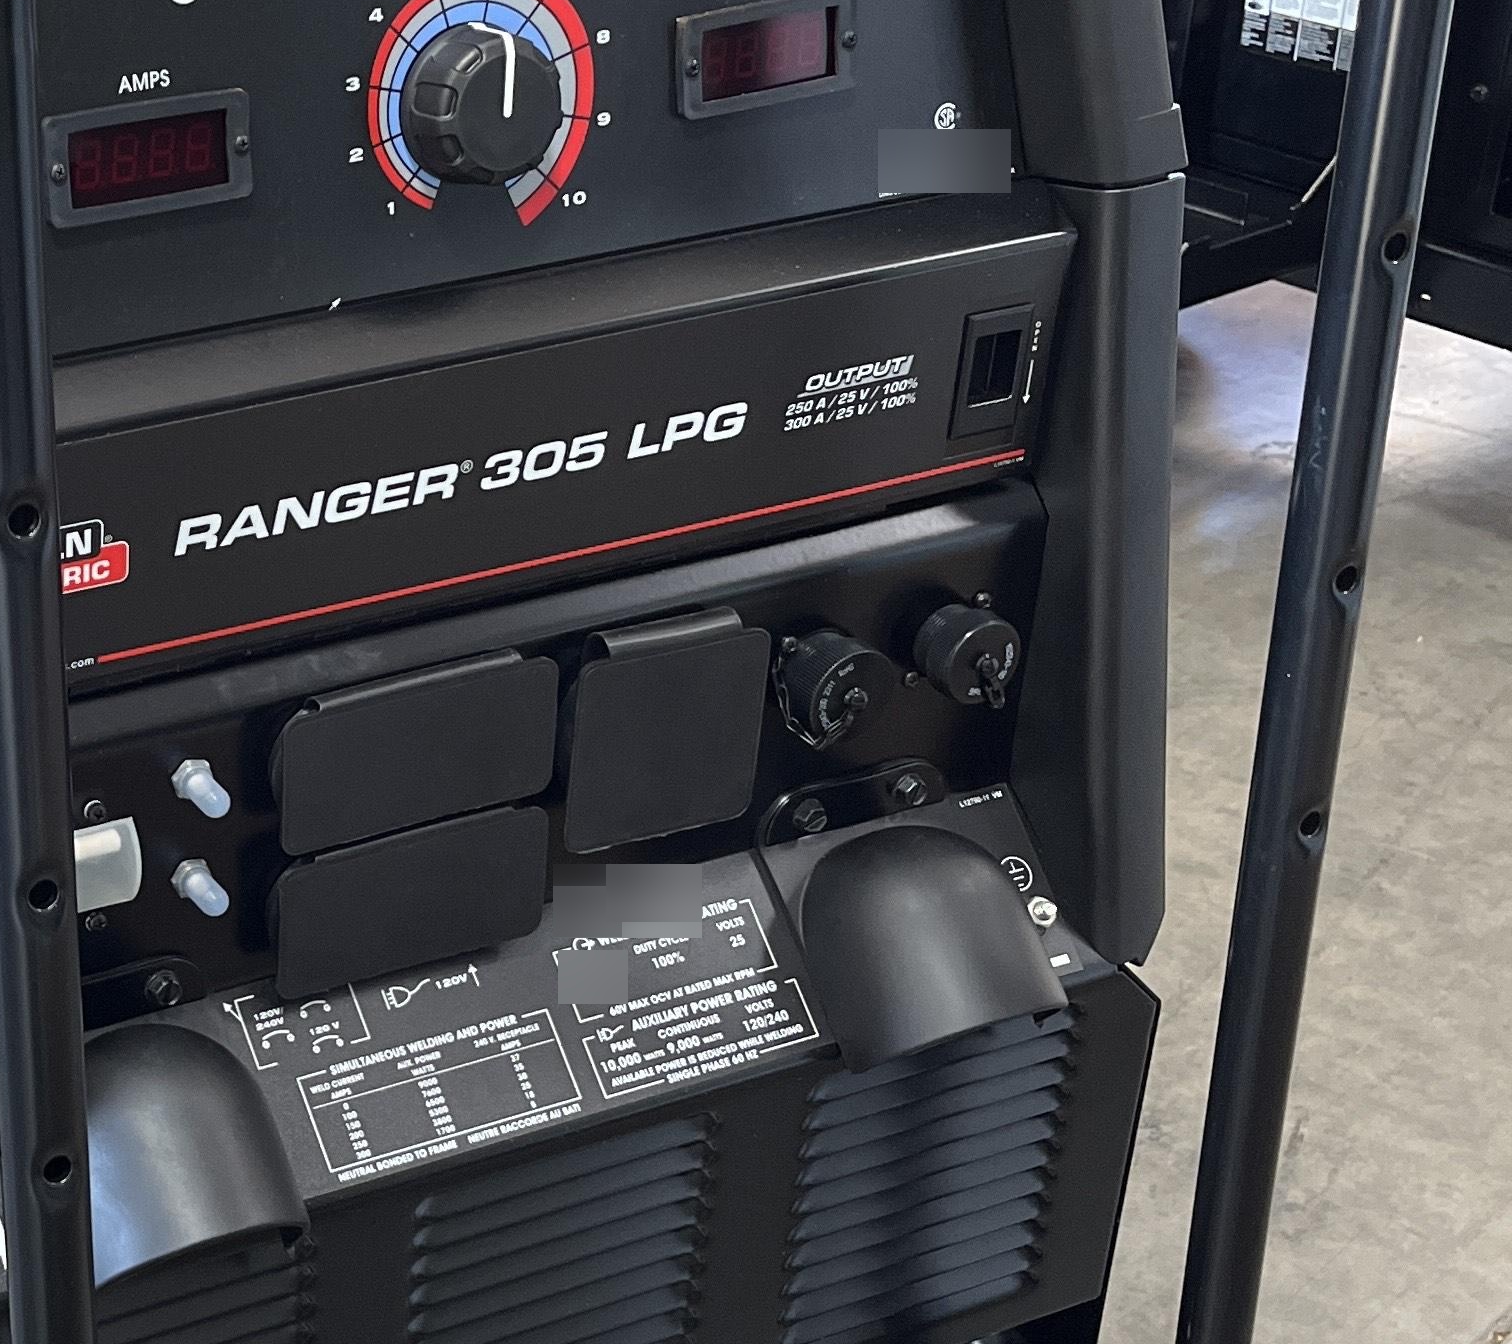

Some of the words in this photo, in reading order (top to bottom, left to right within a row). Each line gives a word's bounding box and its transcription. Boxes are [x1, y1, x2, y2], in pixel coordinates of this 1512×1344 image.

[368, 7, 384, 23] 4
[596, 29, 611, 44] 8
[118, 68, 171, 94] AMPS
[345, 76, 361, 92] 3
[596, 111, 611, 127] 9
[348, 148, 364, 163] 2
[561, 190, 587, 207] 10
[387, 202, 396, 216] 1
[805, 356, 908, 392] OUTPUT
[785, 399, 814, 416] 250
[783, 415, 811, 431] 300
[480, 431, 608, 491] 305
[626, 402, 748, 461] LPG
[701, 898, 738, 919] ATING
[715, 916, 745, 931] VOLTS
[632, 940, 657, 955] DUTY
[729, 933, 746, 948] 25
[651, 951, 686, 969] 100%
[435, 972, 467, 989] 120V
[609, 1003, 627, 1016] 60V
[628, 997, 650, 1011] MAX
[650, 991, 672, 1004] OCV
[673, 987, 684, 999] AT
[684, 979, 713, 995] RATED
[712, 974, 735, 987] MAX
[733, 967, 755, 981] RPM
[632, 1004, 689, 1031] AUXILIARY
[689, 992, 734, 1014] POWER
[734, 980, 778, 1002] RATING
[744, 998, 775, 1014] VOLTS
[255, 1016, 284, 1031] 240V
[309, 1024, 331, 1036] 120
[331, 1021, 340, 1029] V
[657, 1013, 721, 1039] CONTINUOUS
[742, 1009, 790, 1032] 120/240
[329, 1045, 407, 1076] SIMULTANEOUS
[406, 1031, 455, 1054] WELDING
[456, 1025, 479, 1040] AND
[479, 1014, 518, 1033] POWER
[610, 1037, 637, 1053] PEAK
[666, 1035, 701, 1054] 9,000
[414, 1051, 442, 1065] POWER
[600, 1052, 642, 1073] 10,000
[611, 1066, 655, 1087] AVAILABLE
[654, 1057, 687, 1074] POWER
[687, 1054, 697, 1065] IS
[696, 1043, 738, 1062] REDUCED
[737, 1034, 765, 1050] WHILE
[764, 1023, 804, 1042] WELDING
[667, 1065, 701, 1084] SINGLE
[700, 1057, 731, 1074] PHASE
[731, 1053, 745, 1065] 60
[309, 1082, 331, 1094] WELD
[331, 1072, 365, 1088] CURRENT
[330, 1087, 352, 1100] AMPS
[342, 1110, 358, 1121] 100
[467, 1127, 500, 1144] NEUTRE
[499, 1112, 549, 1134] RACCORDE
[549, 1108, 562, 1120] AU
[338, 1164, 377, 1183] NEUTRAL
[376, 1153, 414, 1172] BONDED
[414, 1148, 428, 1160] TO
[427, 1140, 458, 1156] FRAME
